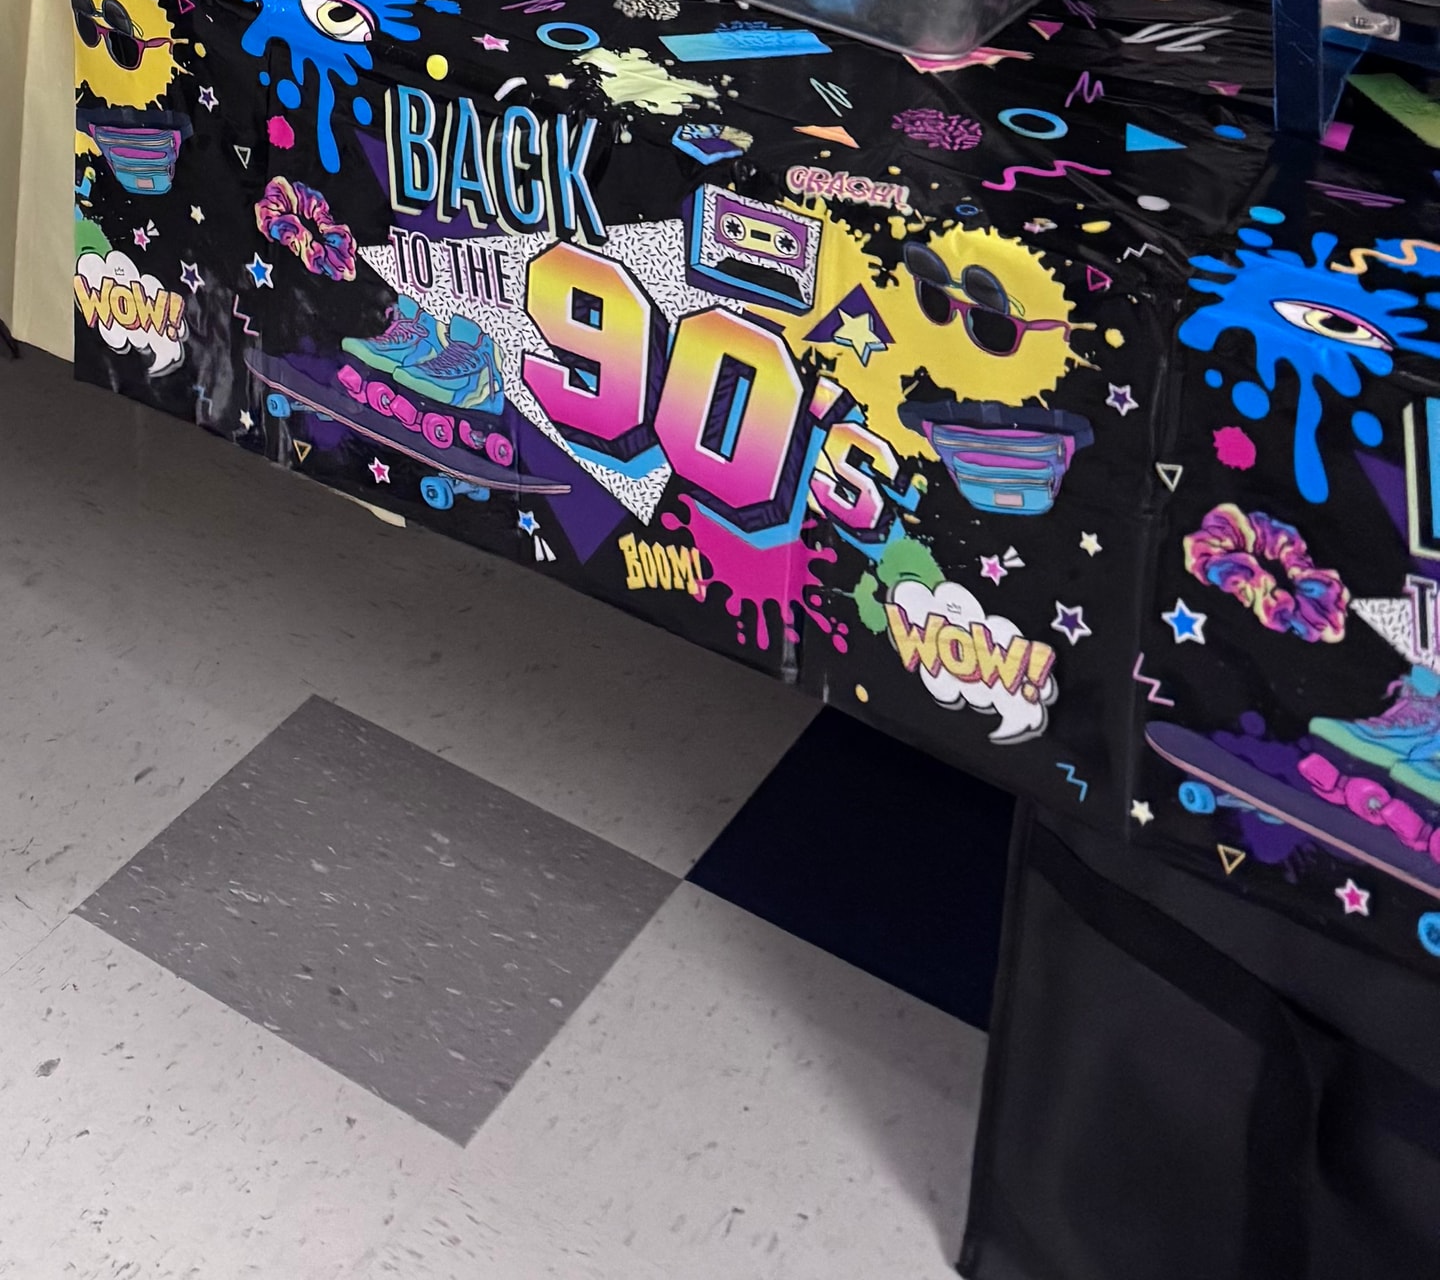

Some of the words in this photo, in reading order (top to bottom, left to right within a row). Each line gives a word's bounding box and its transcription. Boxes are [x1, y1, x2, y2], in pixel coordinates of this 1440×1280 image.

[385, 85, 606, 239] BACK
[786, 165, 913, 216] CRASH!
[389, 226, 435, 291] TO
[442, 238, 515, 308] THE
[73, 273, 186, 342] WOW!
[618, 532, 707, 598] BOOM!
[884, 601, 1058, 703] WOW!
